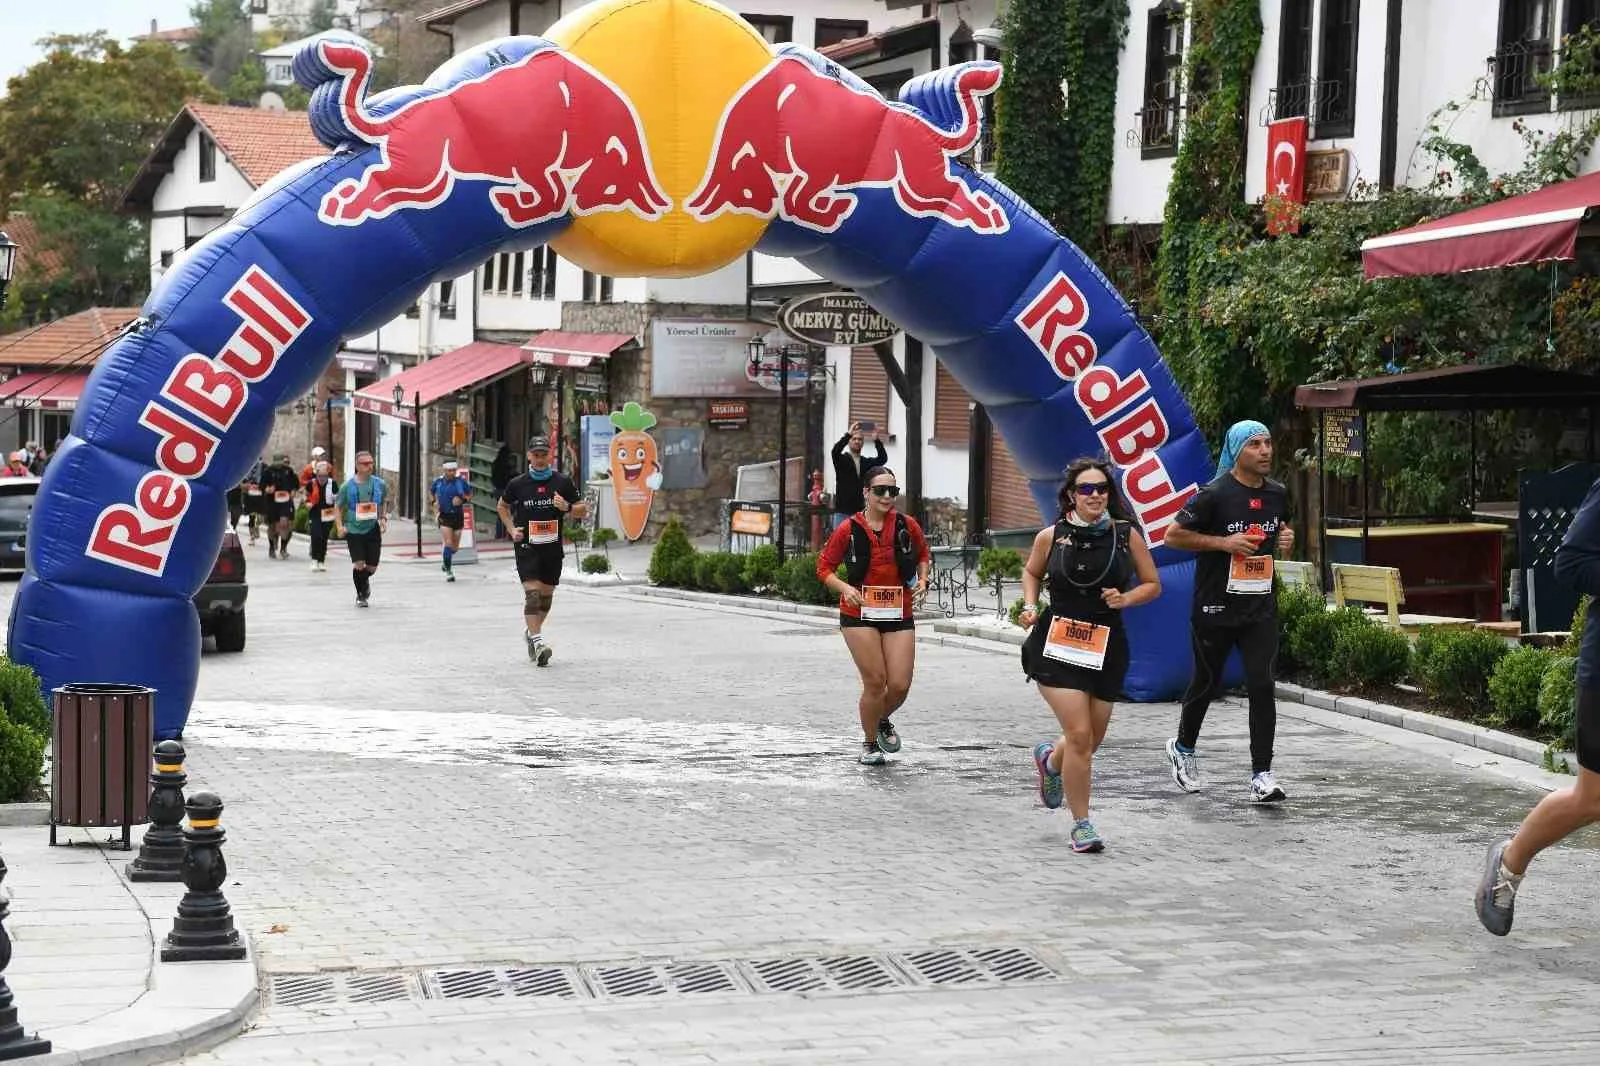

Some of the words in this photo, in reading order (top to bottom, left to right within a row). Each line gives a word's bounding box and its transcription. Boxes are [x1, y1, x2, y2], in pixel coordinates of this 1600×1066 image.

[793, 312, 843, 329] MERVE
[666, 327, 699, 336] Yöresel
[701, 325, 737, 336] Ürünler
[834, 329, 859, 343] EVİ
[1065, 626, 1093, 642] 19001
